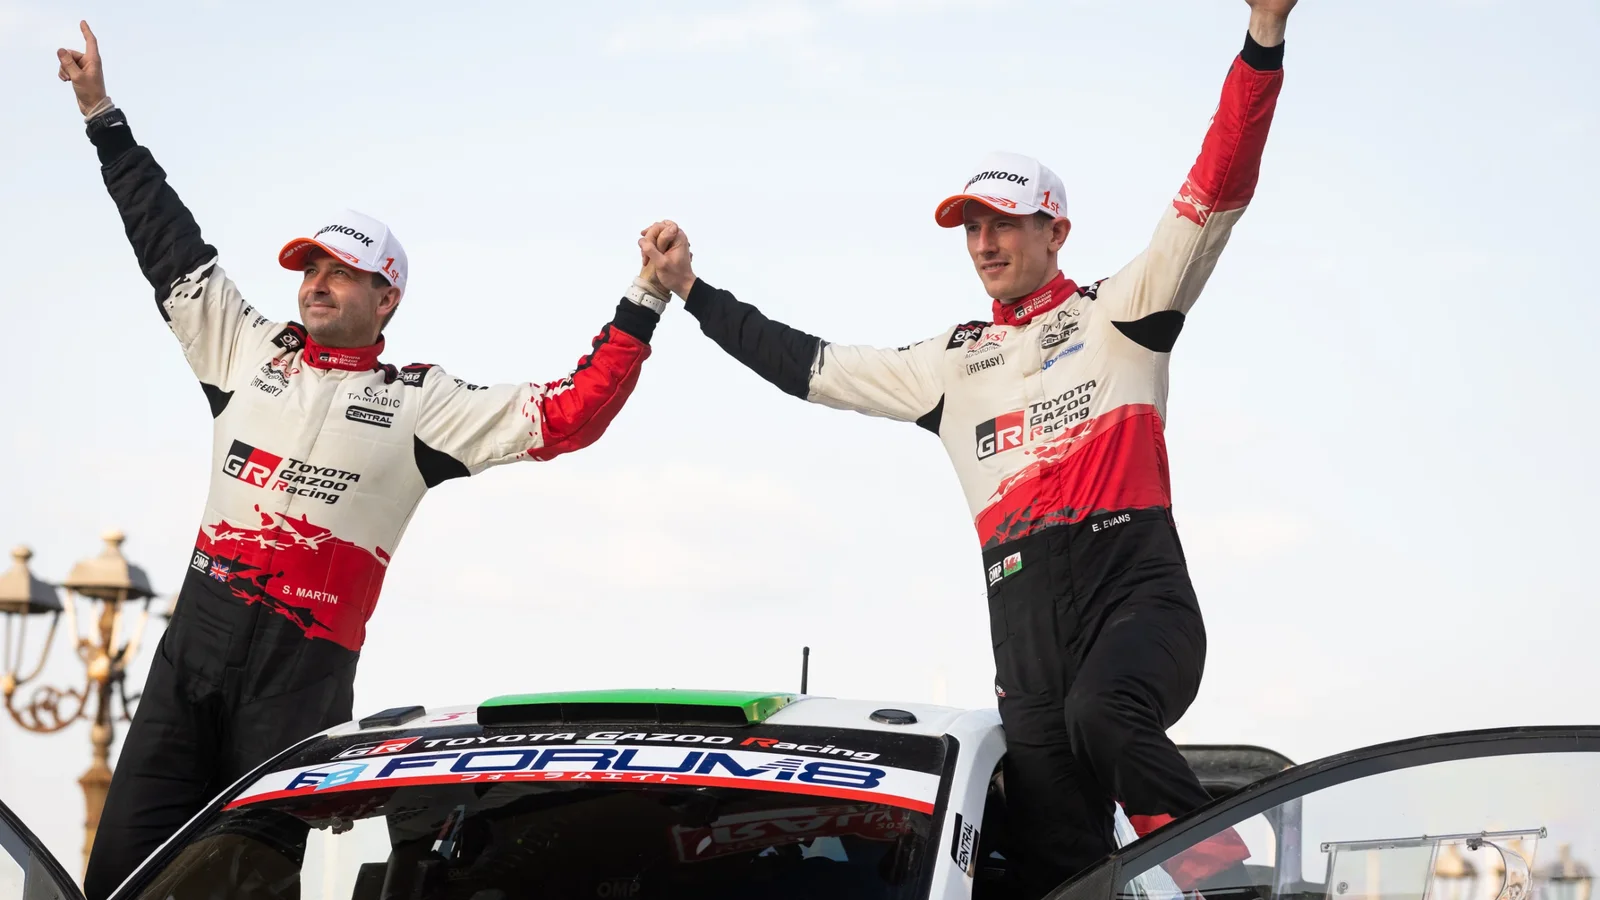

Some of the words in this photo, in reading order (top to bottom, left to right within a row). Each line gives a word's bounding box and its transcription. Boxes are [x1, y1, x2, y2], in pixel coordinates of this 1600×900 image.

[1041, 191, 1060, 214] 1st
[382, 257, 400, 282] 1st
[1029, 379, 1097, 414] TOYOTA
[345, 409, 393, 424] CENTRAL
[1029, 394, 1091, 428] GAZOO
[1029, 406, 1090, 441] Racing
[977, 425, 1023, 459] GR
[223, 454, 272, 487] GR
[279, 469, 349, 492] GAZOO
[288, 458, 361, 483] TOYOTA
[271, 480, 340, 505] Racing
[1092, 523, 1102, 532] E.
[1103, 513, 1131, 528] EVANS
[193, 554, 209, 570] OMP
[988, 565, 1002, 582] OMP
[282, 585, 293, 596] S.
[296, 587, 339, 605] MARTIN
[339, 743, 409, 758] GR
[424, 732, 577, 749] TOYOTA
[585, 731, 734, 745] GAZOO
[740, 736, 881, 761] Racing
[375, 748, 887, 789] FORUM8
[461, 771, 679, 782] フォーラムエイト
[957, 821, 974, 874] CENTRAL
